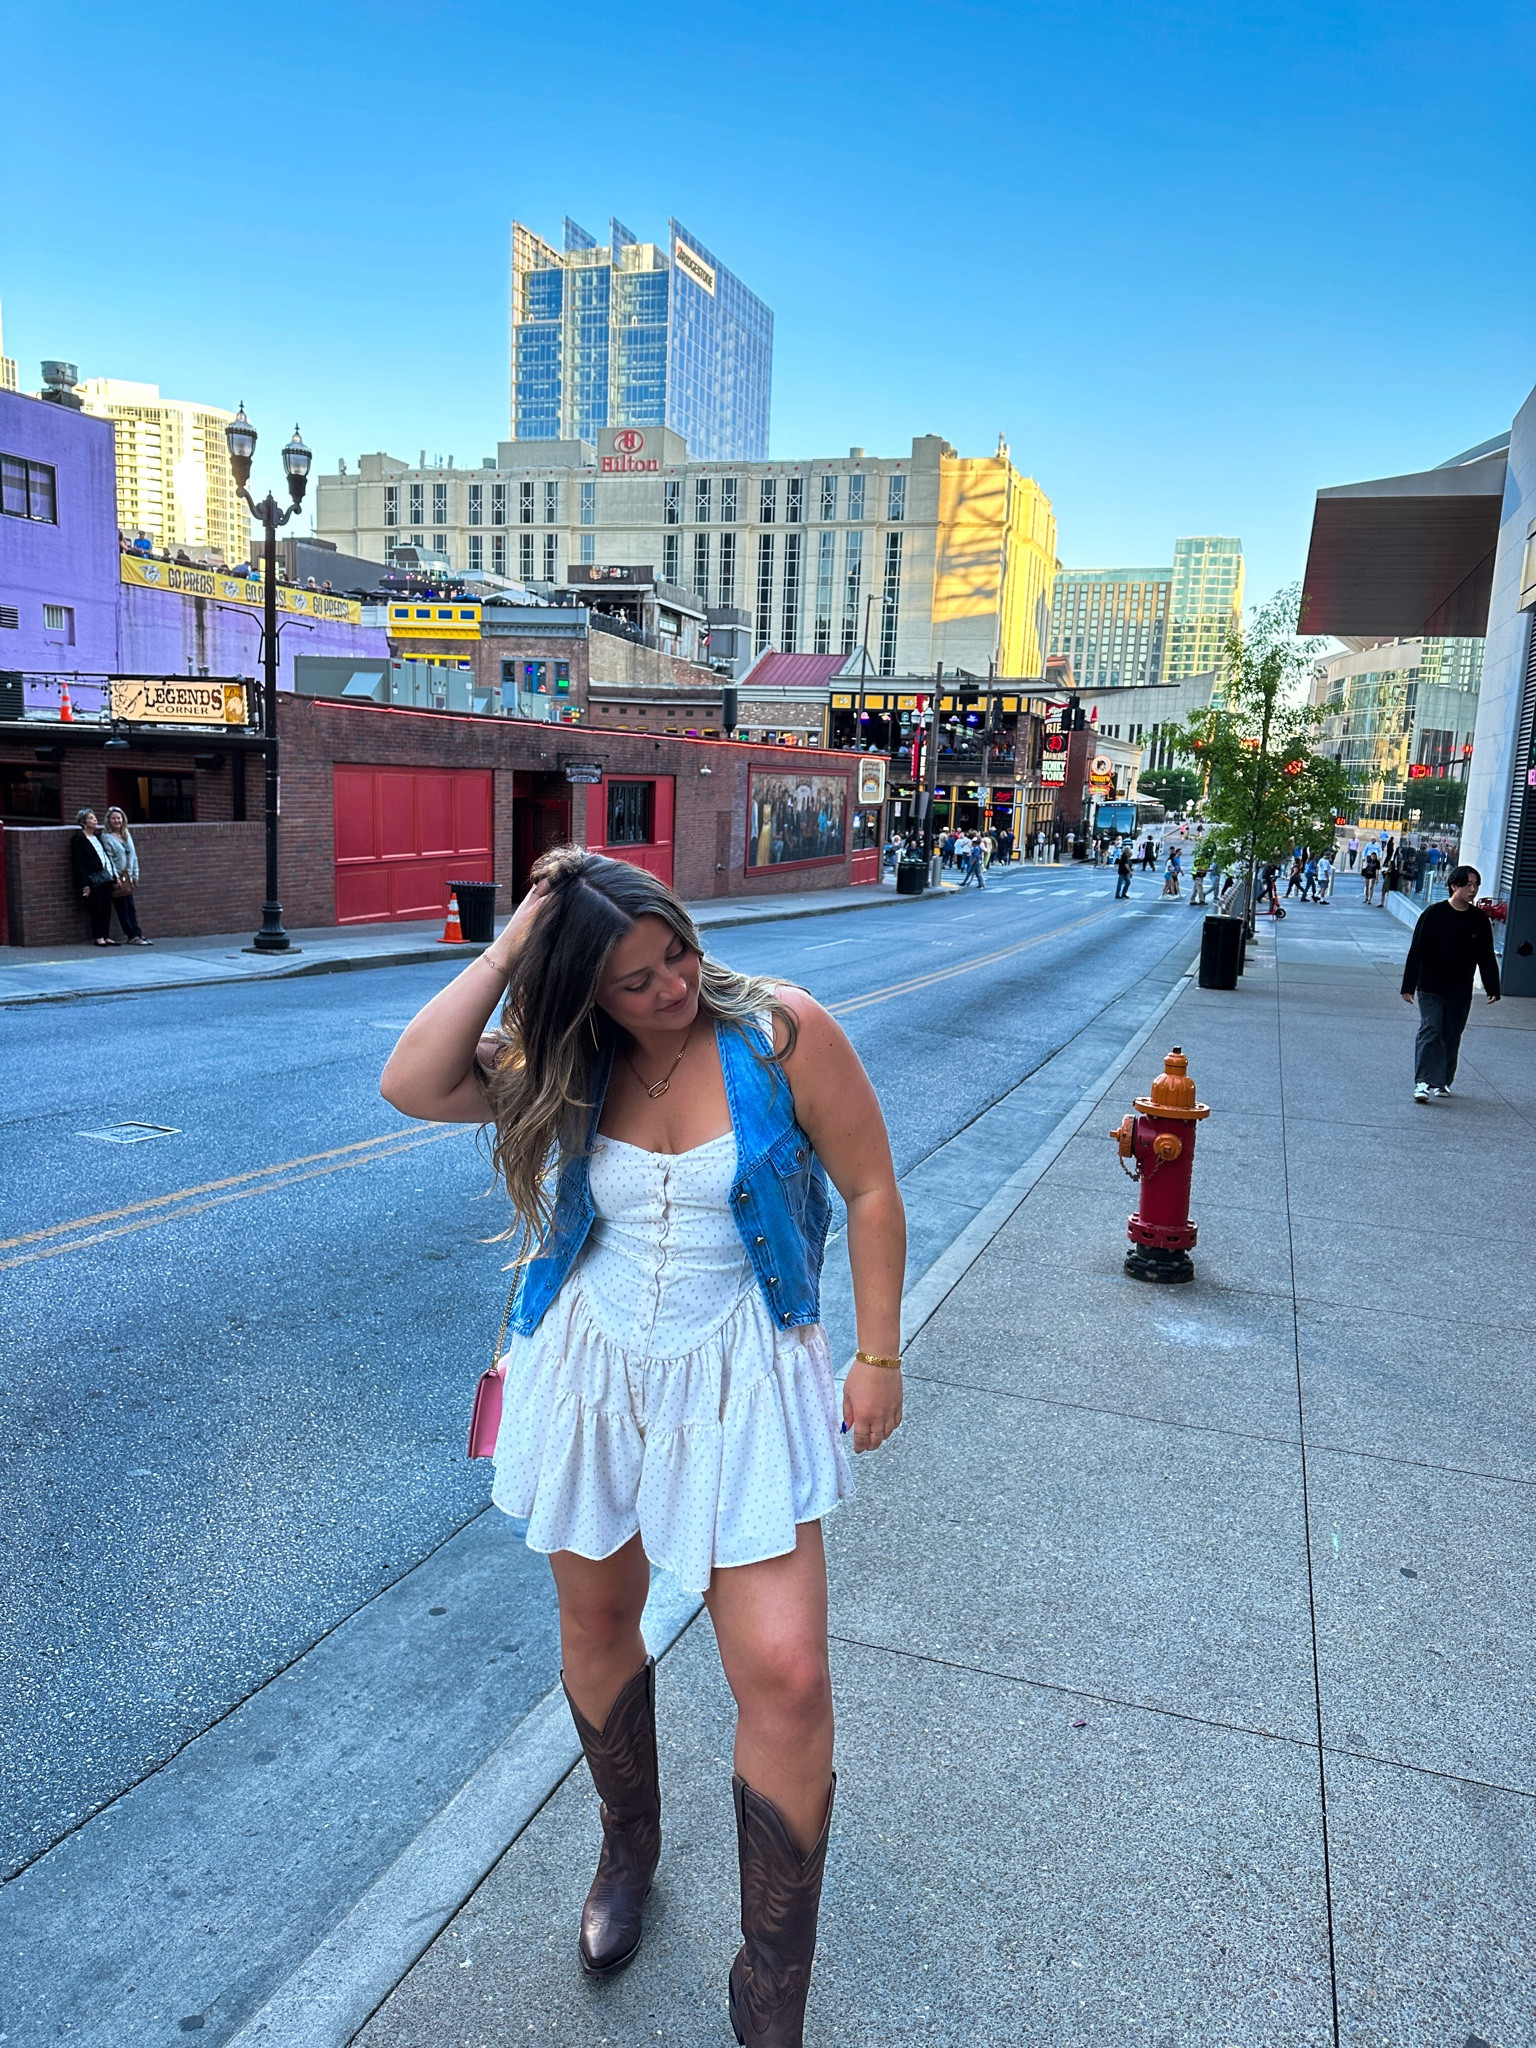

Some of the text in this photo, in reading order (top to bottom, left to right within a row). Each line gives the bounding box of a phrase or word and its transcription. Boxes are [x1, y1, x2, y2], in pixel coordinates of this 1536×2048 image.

[676, 246, 713, 288] BRIDGESTONE
[601, 454, 659, 472] Hilton
[168, 567, 215, 596] GO PREDS!
[245, 583, 257, 602] GO
[312, 596, 349, 620] GO PREDS!
[144, 686, 223, 711] LEGENDS
[156, 705, 209, 715] CORNER
[1042, 760, 1067, 771] HONKY
[1041, 771, 1065, 781] TONK
